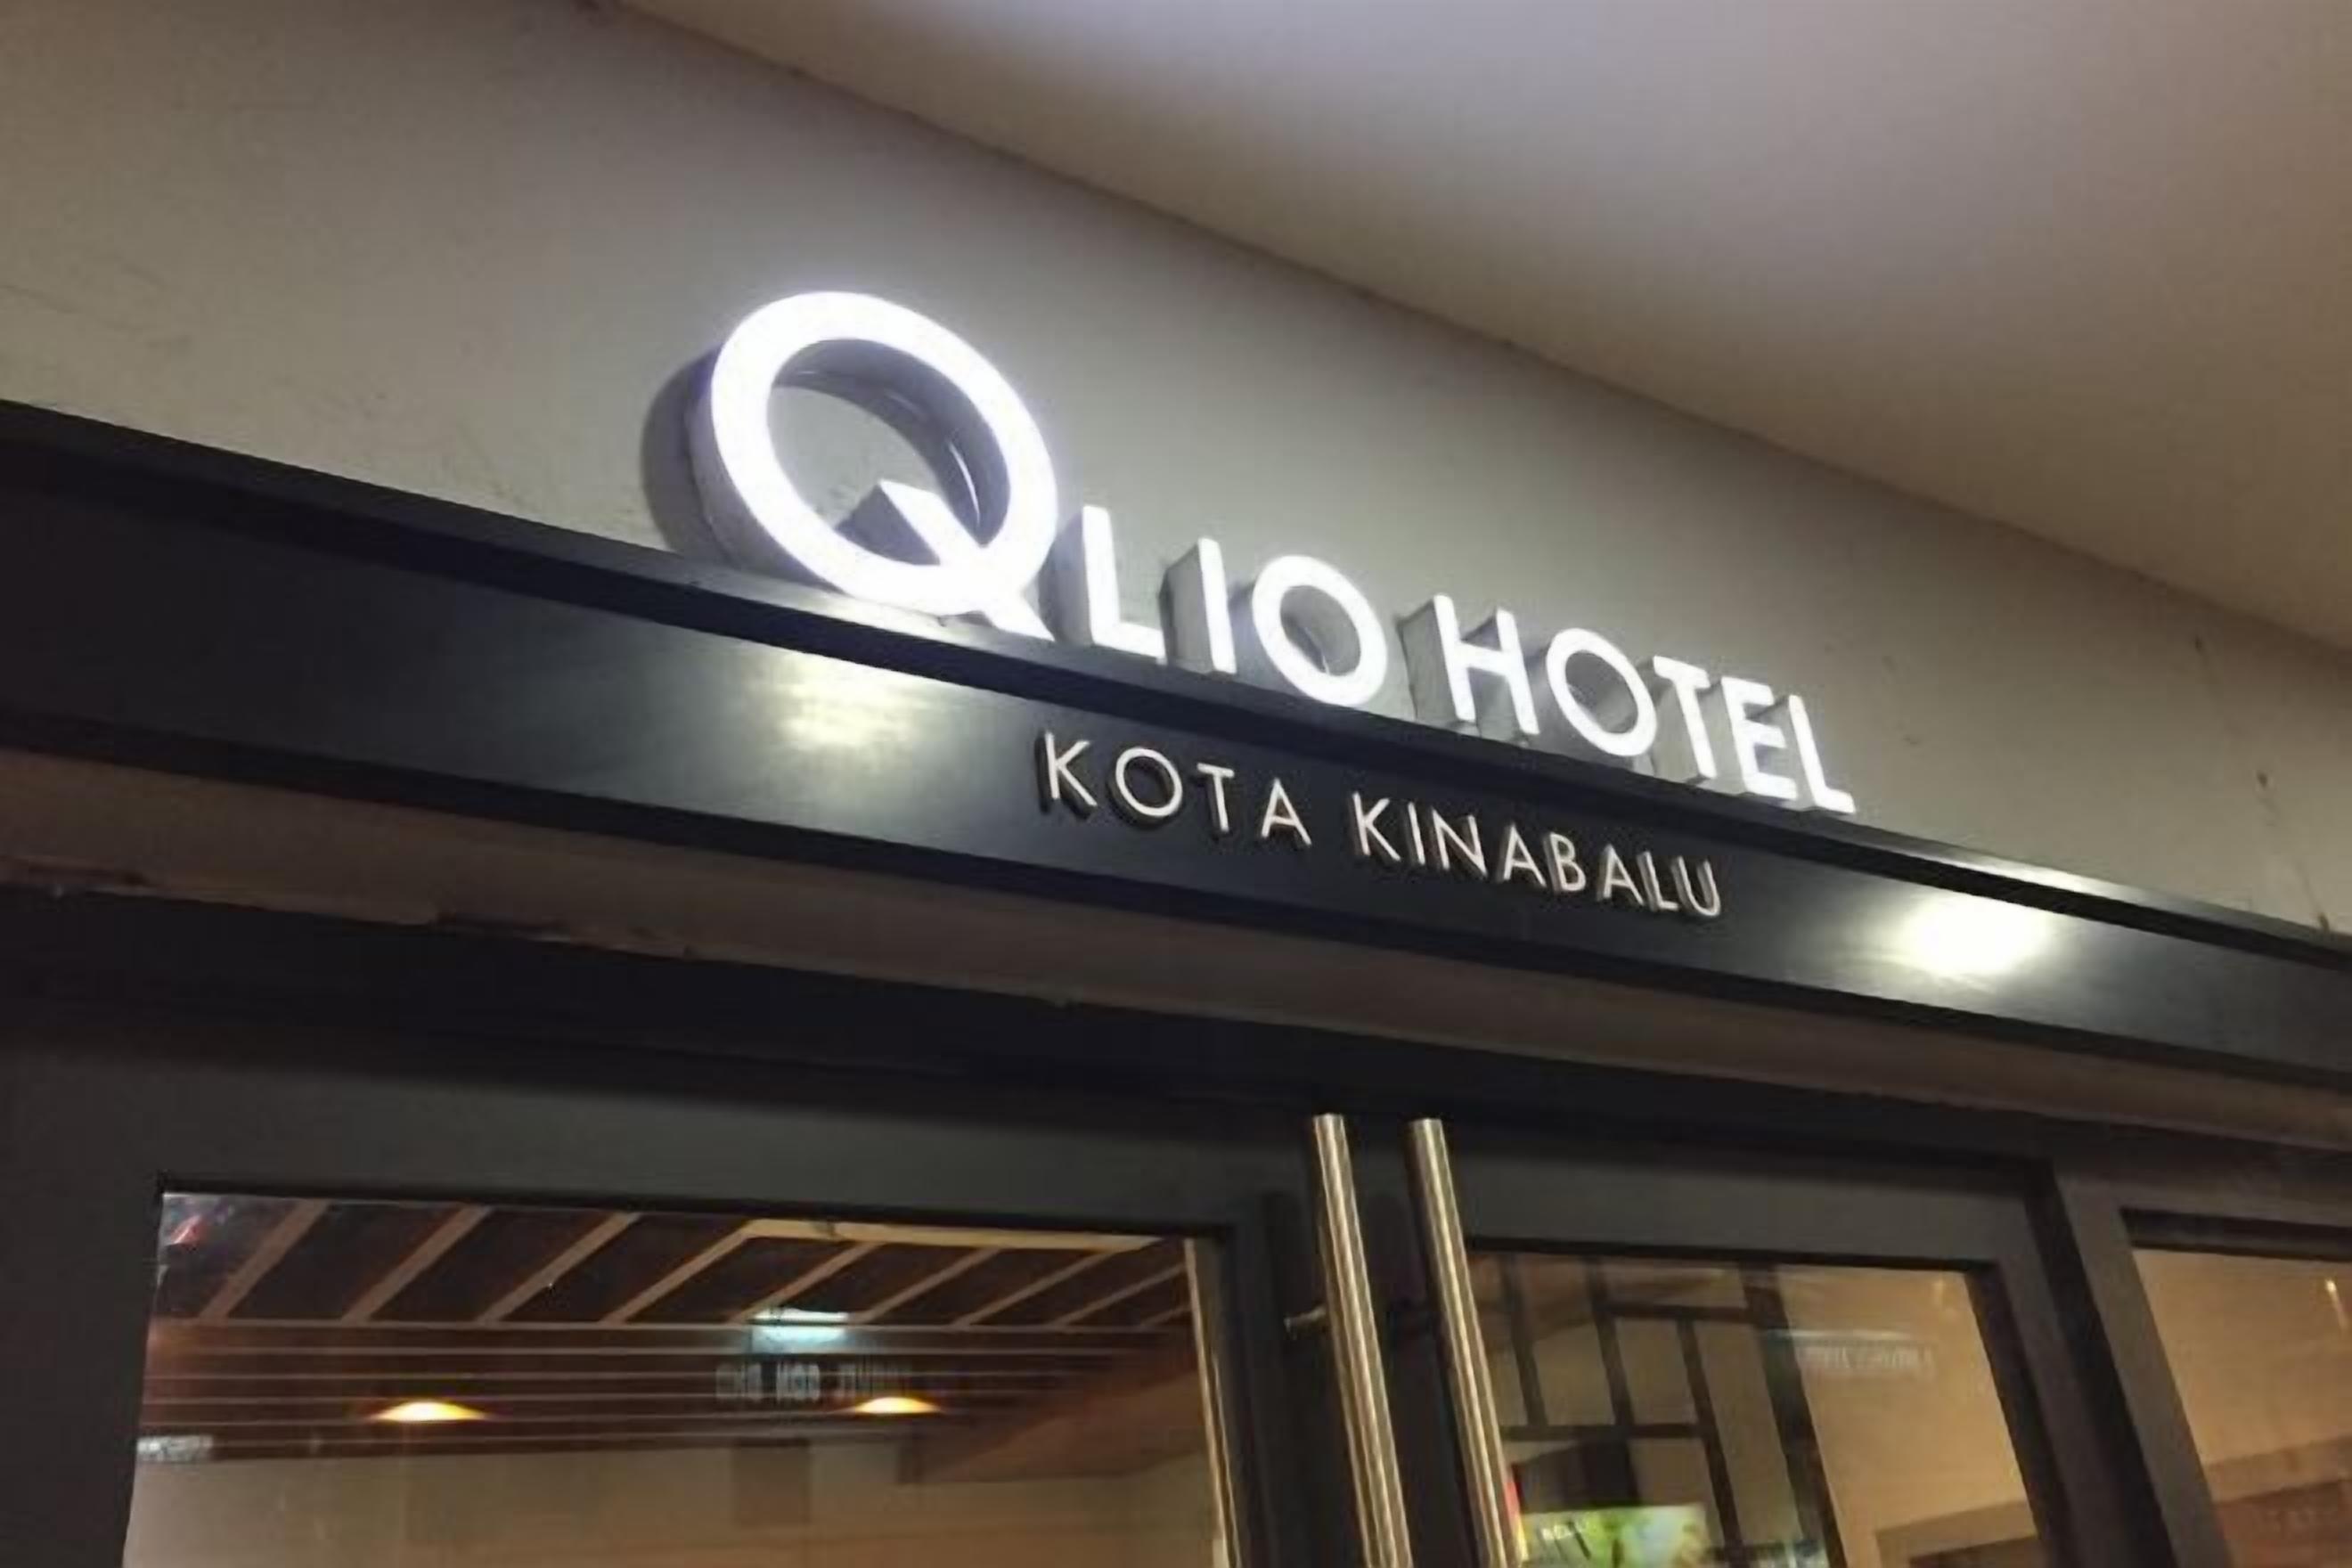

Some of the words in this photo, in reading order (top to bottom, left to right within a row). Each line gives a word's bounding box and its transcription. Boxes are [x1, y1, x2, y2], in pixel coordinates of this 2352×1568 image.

[710, 291, 1387, 706] QLIO
[1433, 594, 1856, 813] HOTEL
[1040, 731, 1312, 846] KOTA
[1351, 790, 1723, 919] KINABALU
